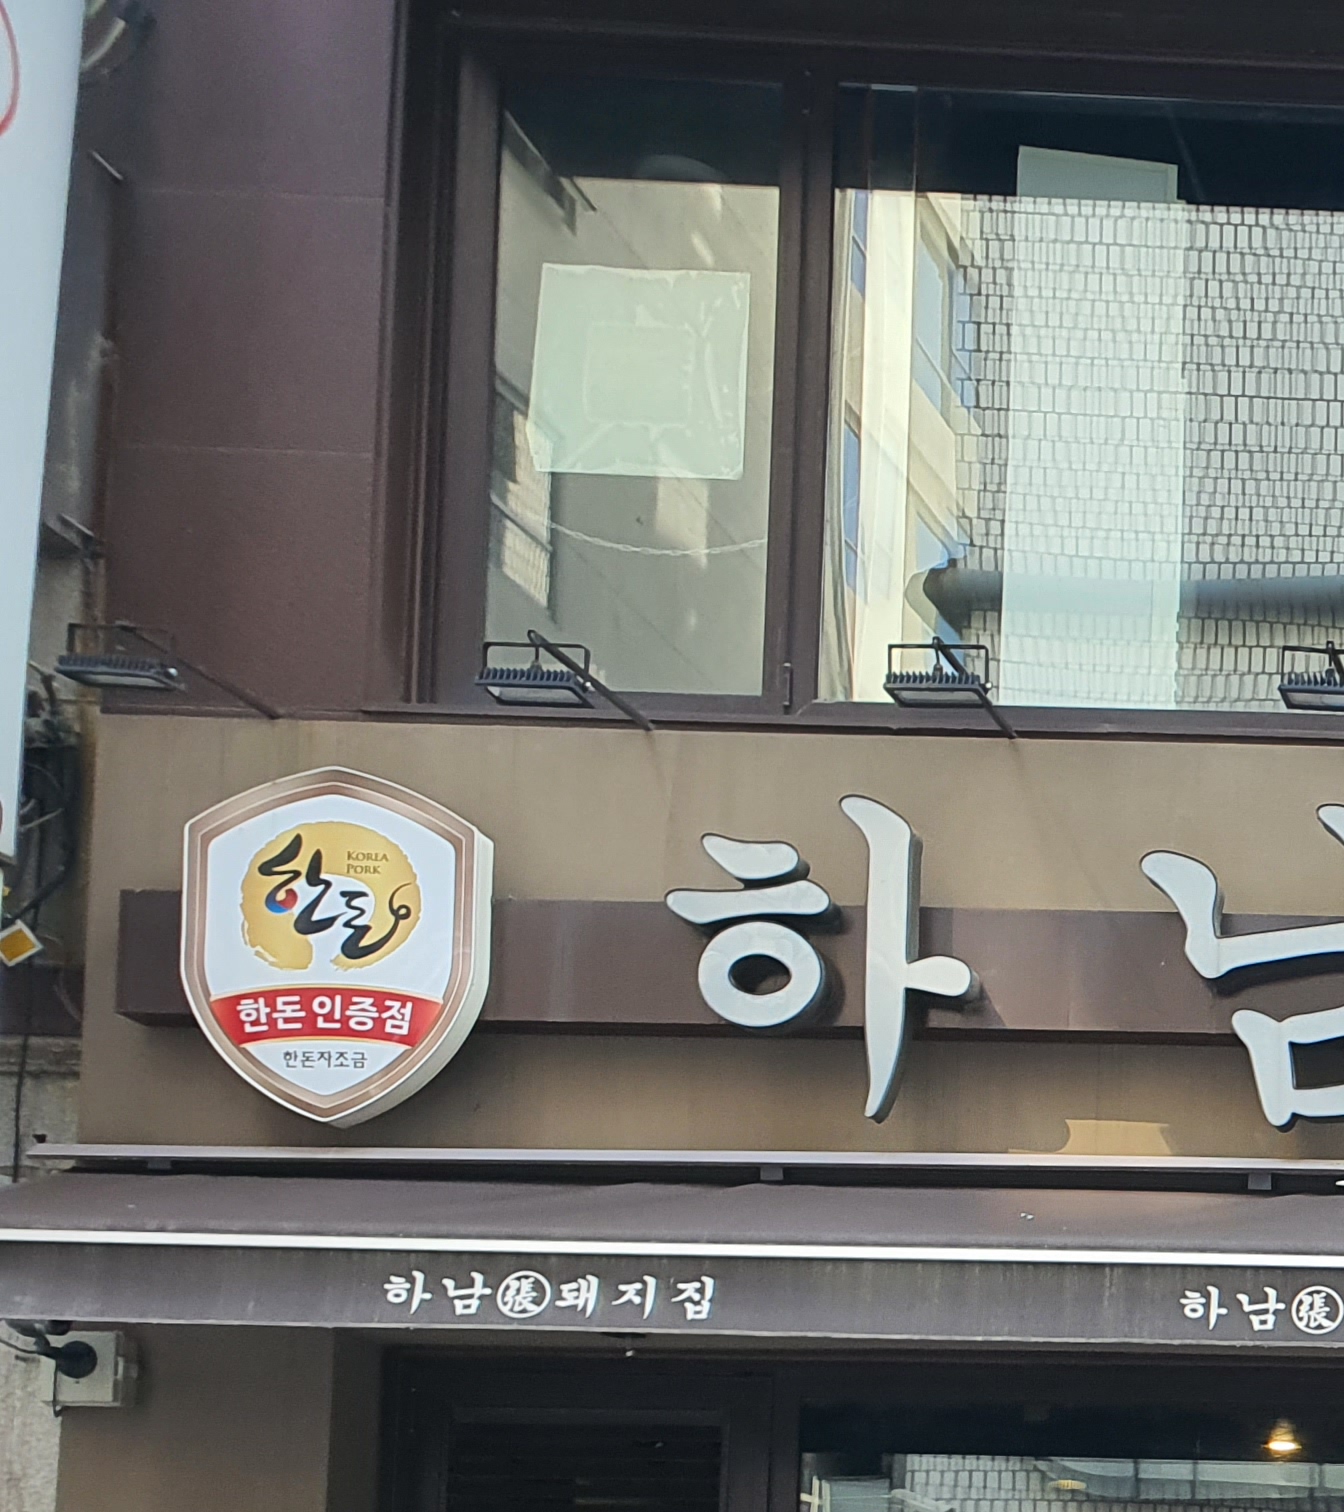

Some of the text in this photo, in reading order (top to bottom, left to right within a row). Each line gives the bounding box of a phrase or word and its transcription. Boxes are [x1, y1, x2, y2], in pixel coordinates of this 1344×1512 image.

[346, 850, 390, 863] KOREA
[346, 863, 382, 875] PORK
[236, 995, 413, 1037] 한돈 인증점
[282, 1049, 368, 1070] 한돈자조금
